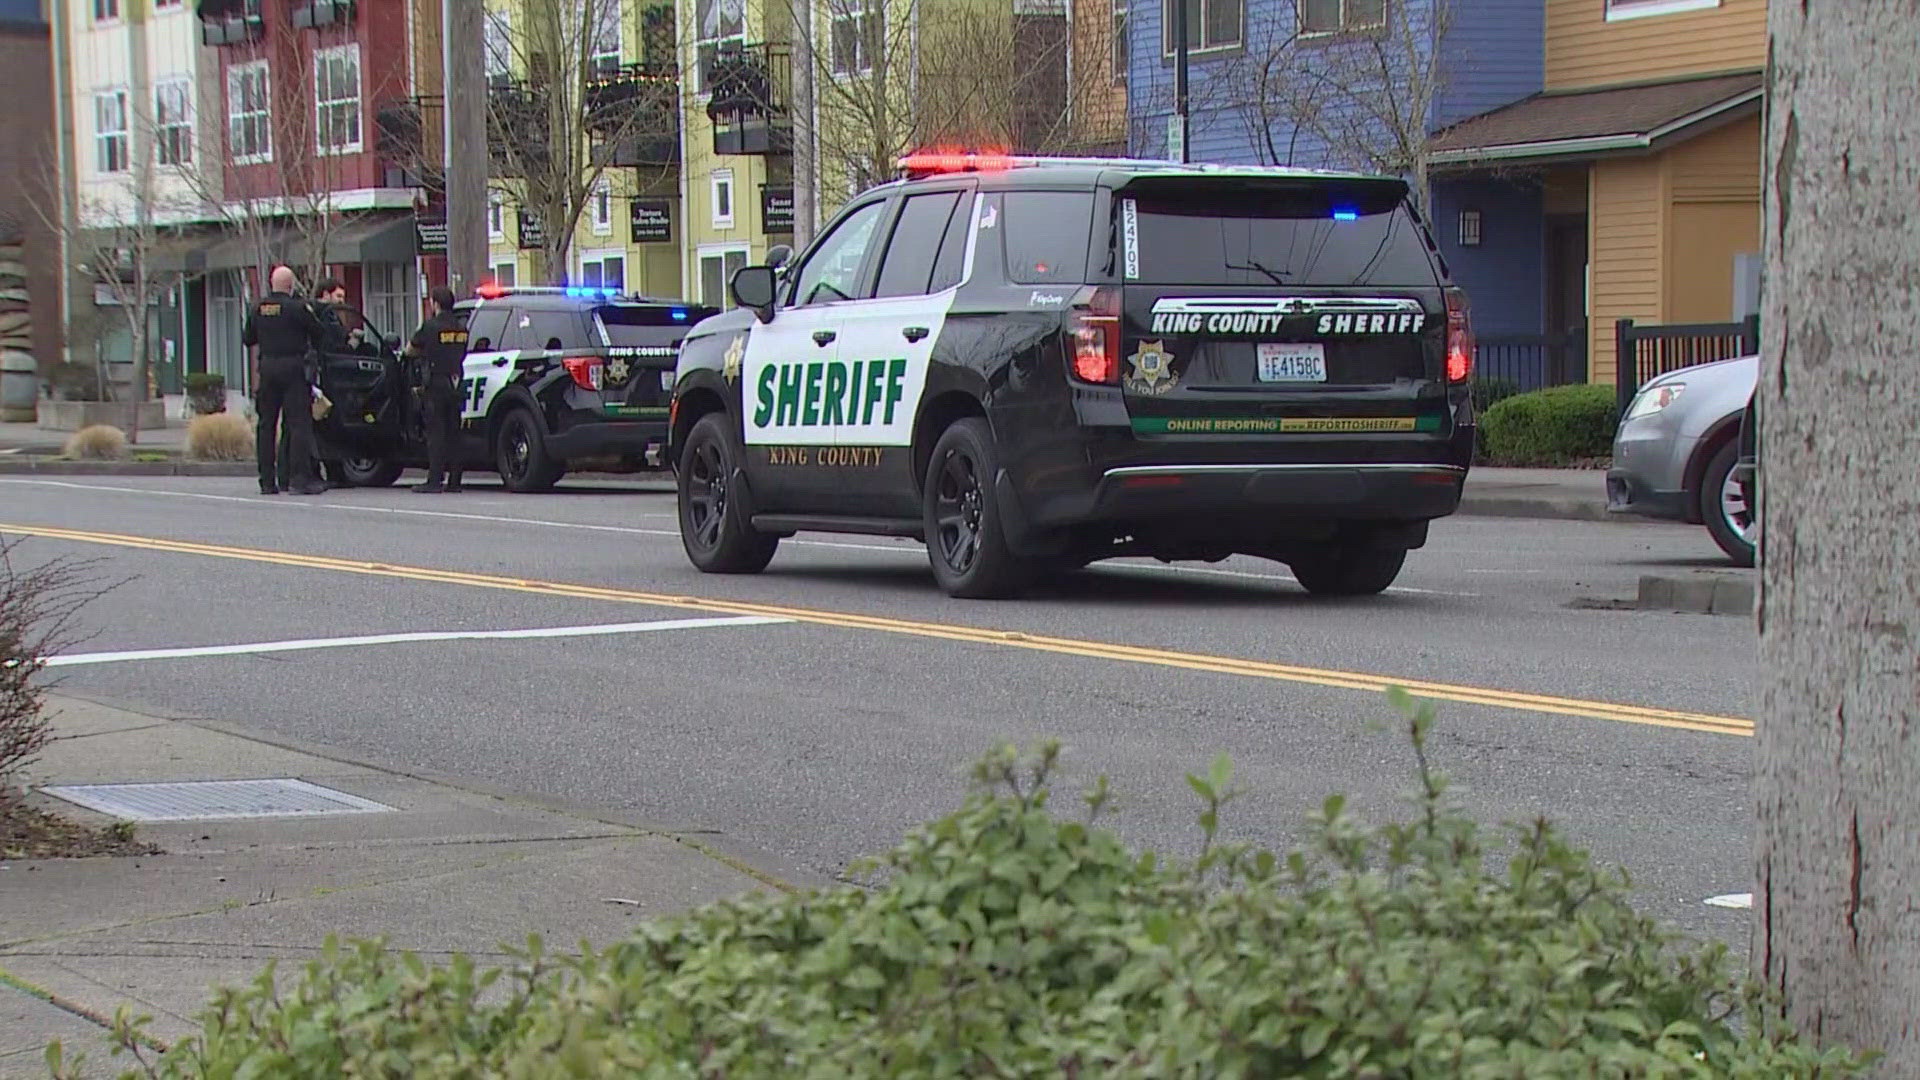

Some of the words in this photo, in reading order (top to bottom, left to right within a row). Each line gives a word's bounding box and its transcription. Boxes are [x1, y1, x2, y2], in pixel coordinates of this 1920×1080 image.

[1125, 200, 1136, 276] E24703
[1151, 314, 1202, 333] KING
[1208, 314, 1284, 333] COUNTY
[1317, 314, 1425, 333] SHERIFF
[609, 347, 634, 356] KING
[635, 347, 671, 356] COUNTY
[1271, 356, 1321, 376] E4158C
[754, 359, 907, 428] SHERIFF
[1167, 419, 1211, 430] ONLINE
[1214, 419, 1278, 430] REPORTING
[770, 447, 808, 465] KING
[818, 447, 883, 466] COUNTY
